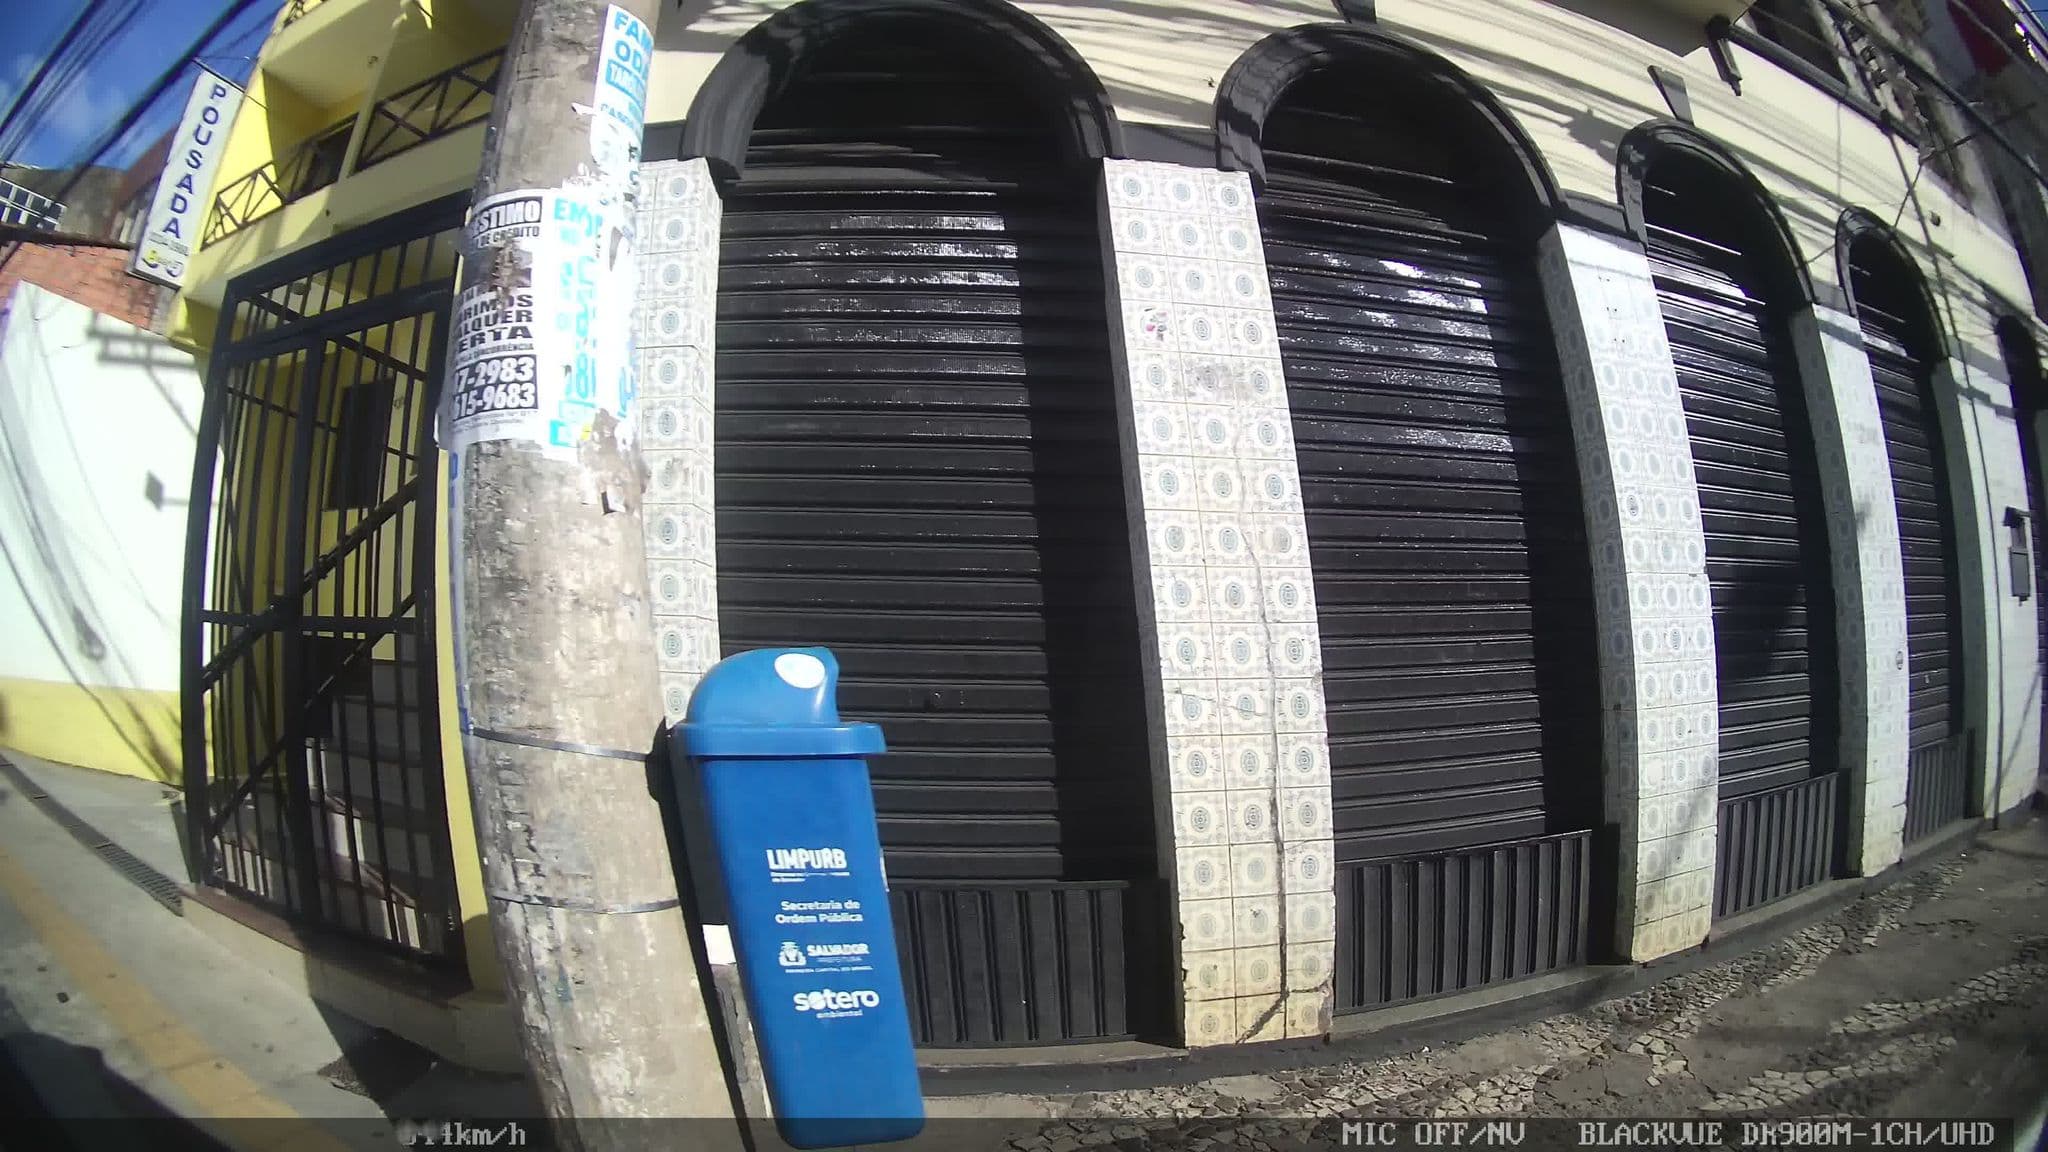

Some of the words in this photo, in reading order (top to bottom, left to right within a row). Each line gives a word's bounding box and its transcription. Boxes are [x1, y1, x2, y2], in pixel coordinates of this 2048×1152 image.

[163, 83, 227, 239] POUSADA
[766, 848, 848, 870] LIMPURB
[781, 900, 843, 911] Secretaria
[844, 899, 861, 910] de
[775, 913, 818, 924] Ordem
[818, 912, 864, 923] Pública
[806, 943, 870, 957] SALVADOR
[793, 988, 880, 1012] sotero
